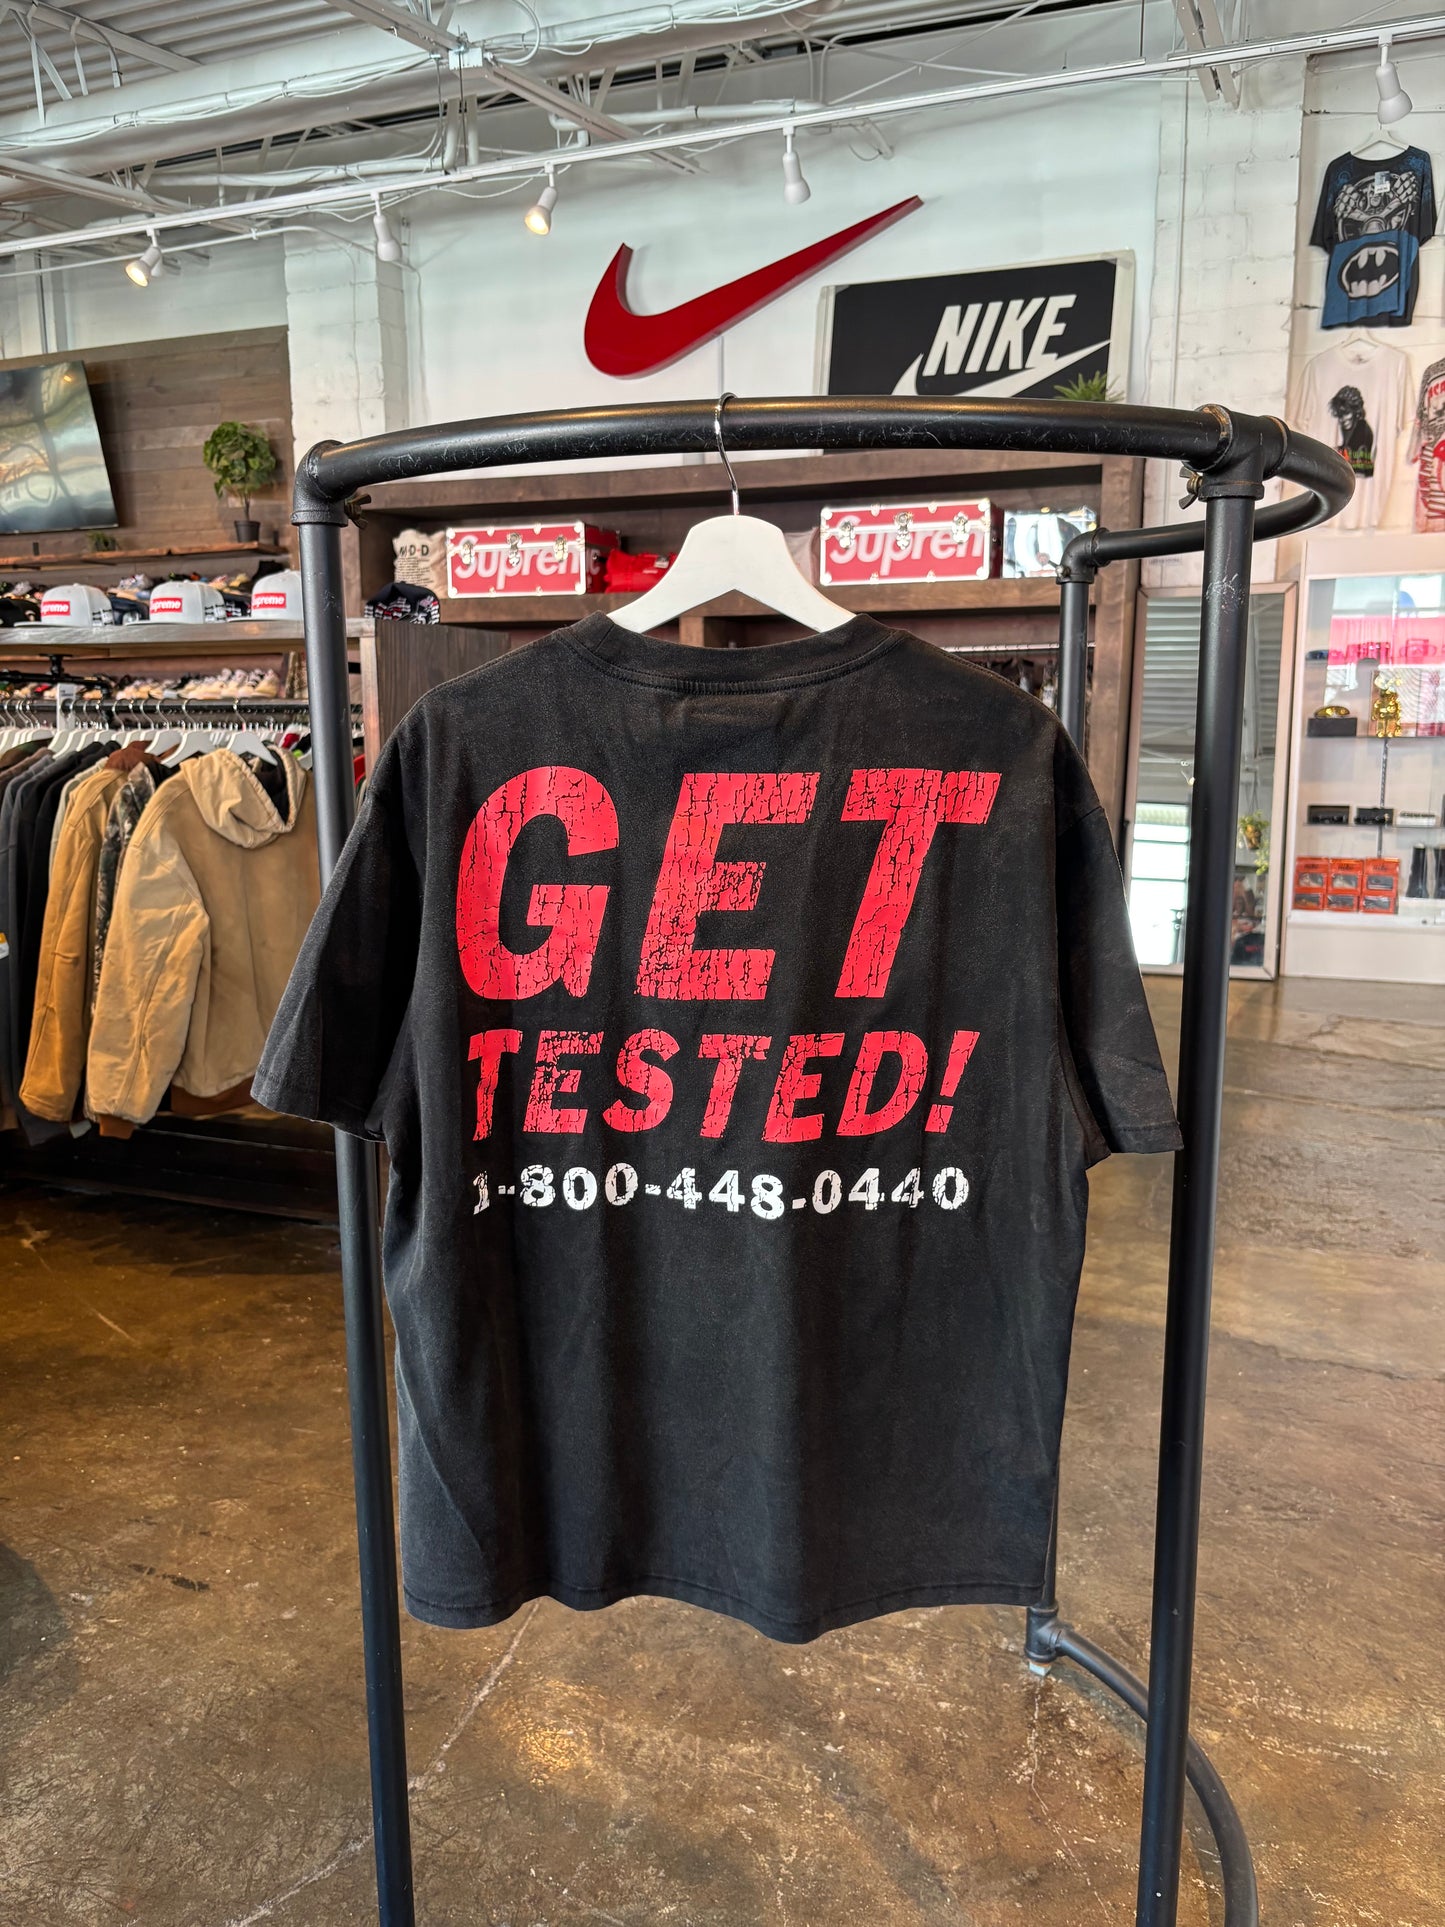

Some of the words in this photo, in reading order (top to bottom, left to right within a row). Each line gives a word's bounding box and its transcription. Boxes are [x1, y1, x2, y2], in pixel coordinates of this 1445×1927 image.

[922, 294, 1077, 377] NIKE
[456, 766, 1001, 1000] GET
[467, 1029, 980, 1143] TESTED!
